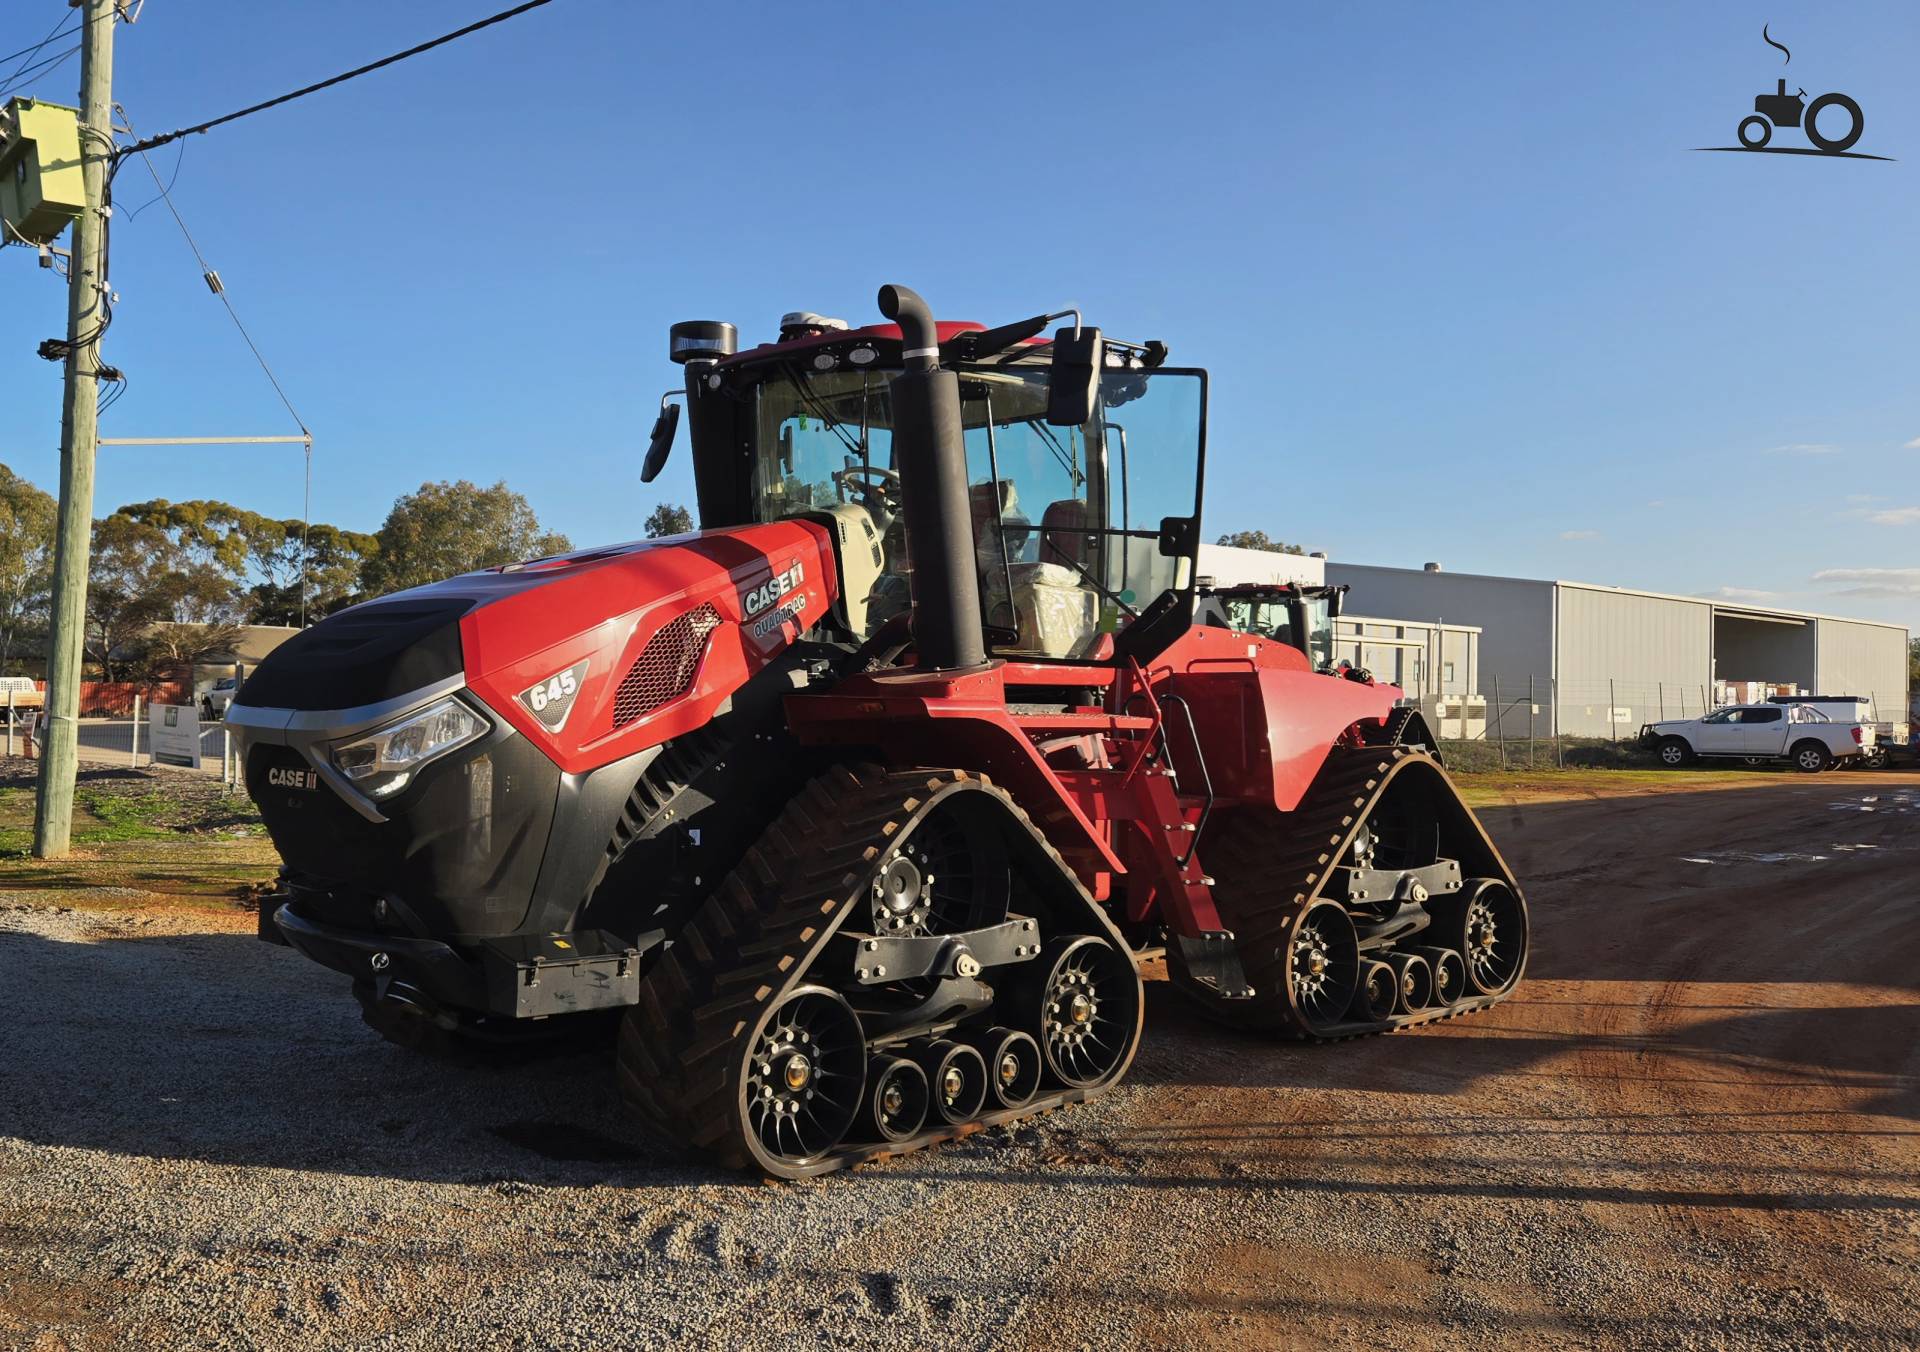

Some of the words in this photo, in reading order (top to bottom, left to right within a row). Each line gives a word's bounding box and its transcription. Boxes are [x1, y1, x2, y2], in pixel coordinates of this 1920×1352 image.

[745, 571, 791, 615] CASE
[753, 593, 807, 638] QUADTRAC
[530, 669, 577, 712] 645
[268, 767, 305, 788] CASE
